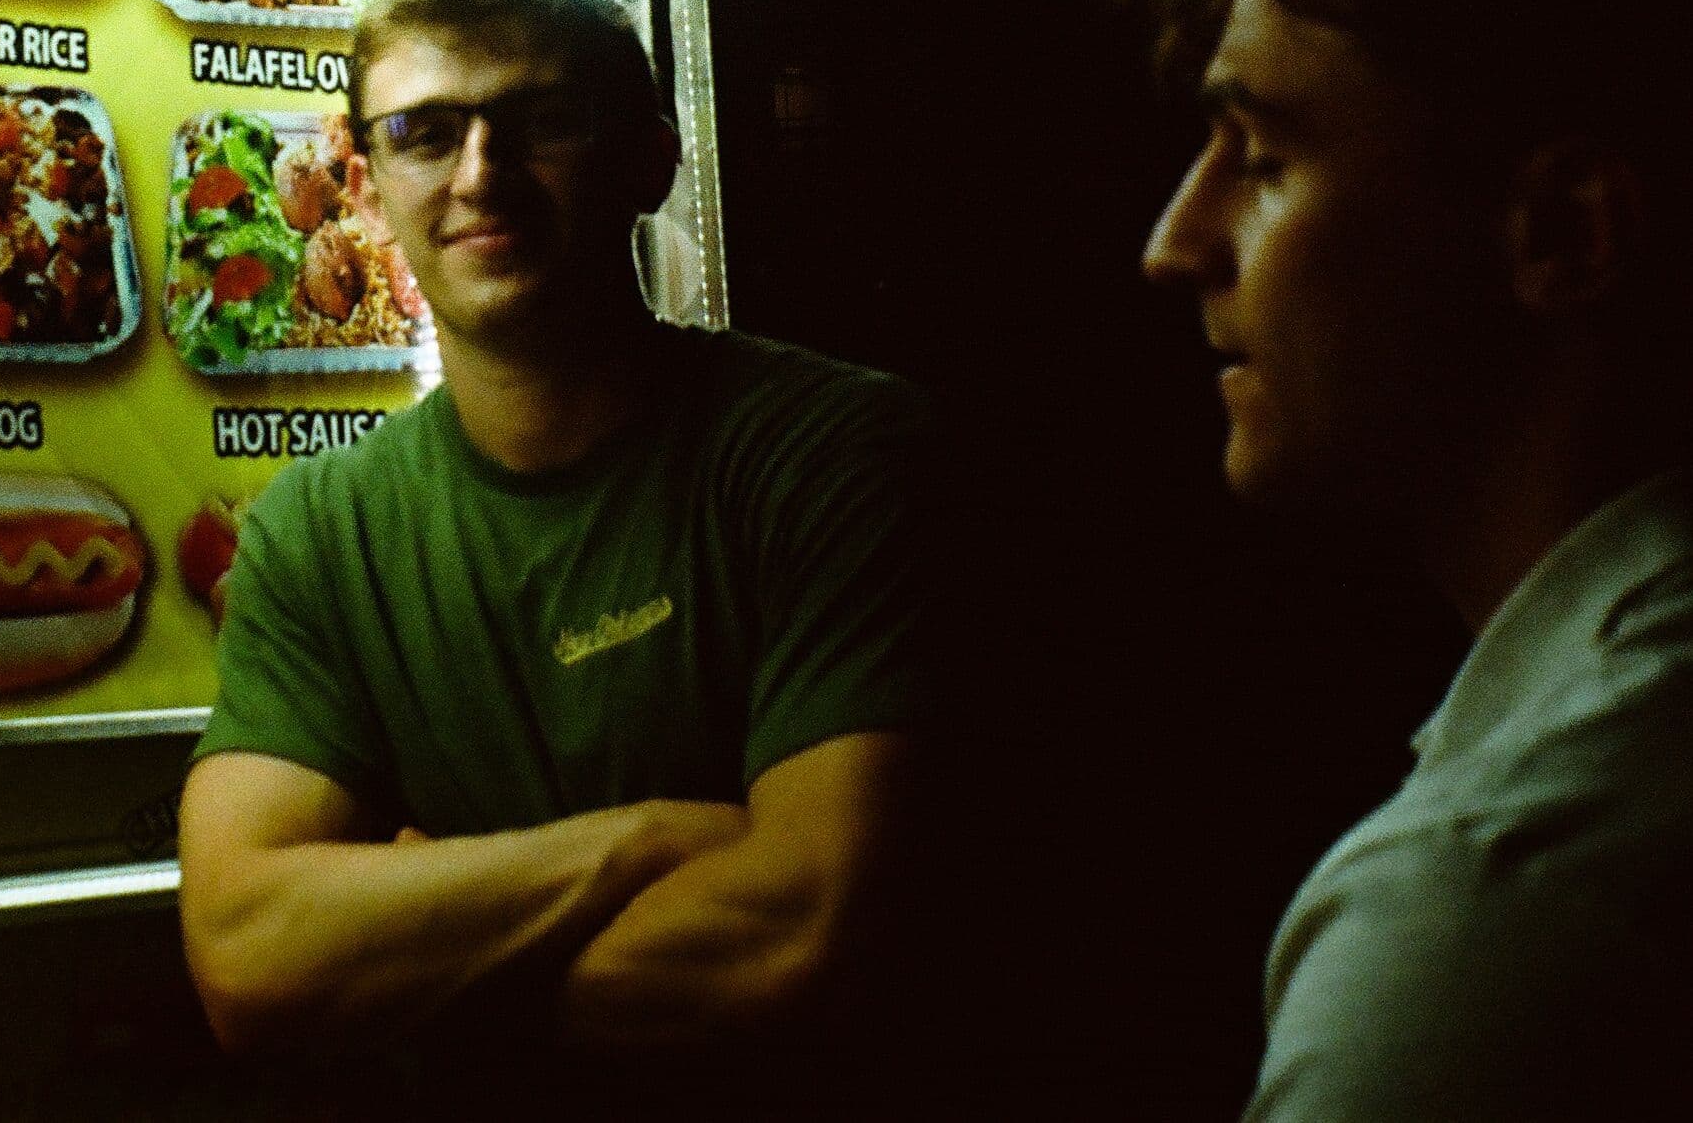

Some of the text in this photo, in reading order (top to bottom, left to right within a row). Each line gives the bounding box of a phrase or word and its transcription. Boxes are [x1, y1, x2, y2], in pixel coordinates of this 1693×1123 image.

[20, 25, 89, 71] RICE
[192, 41, 314, 90] FALAFEL
[216, 411, 285, 455] HOT
